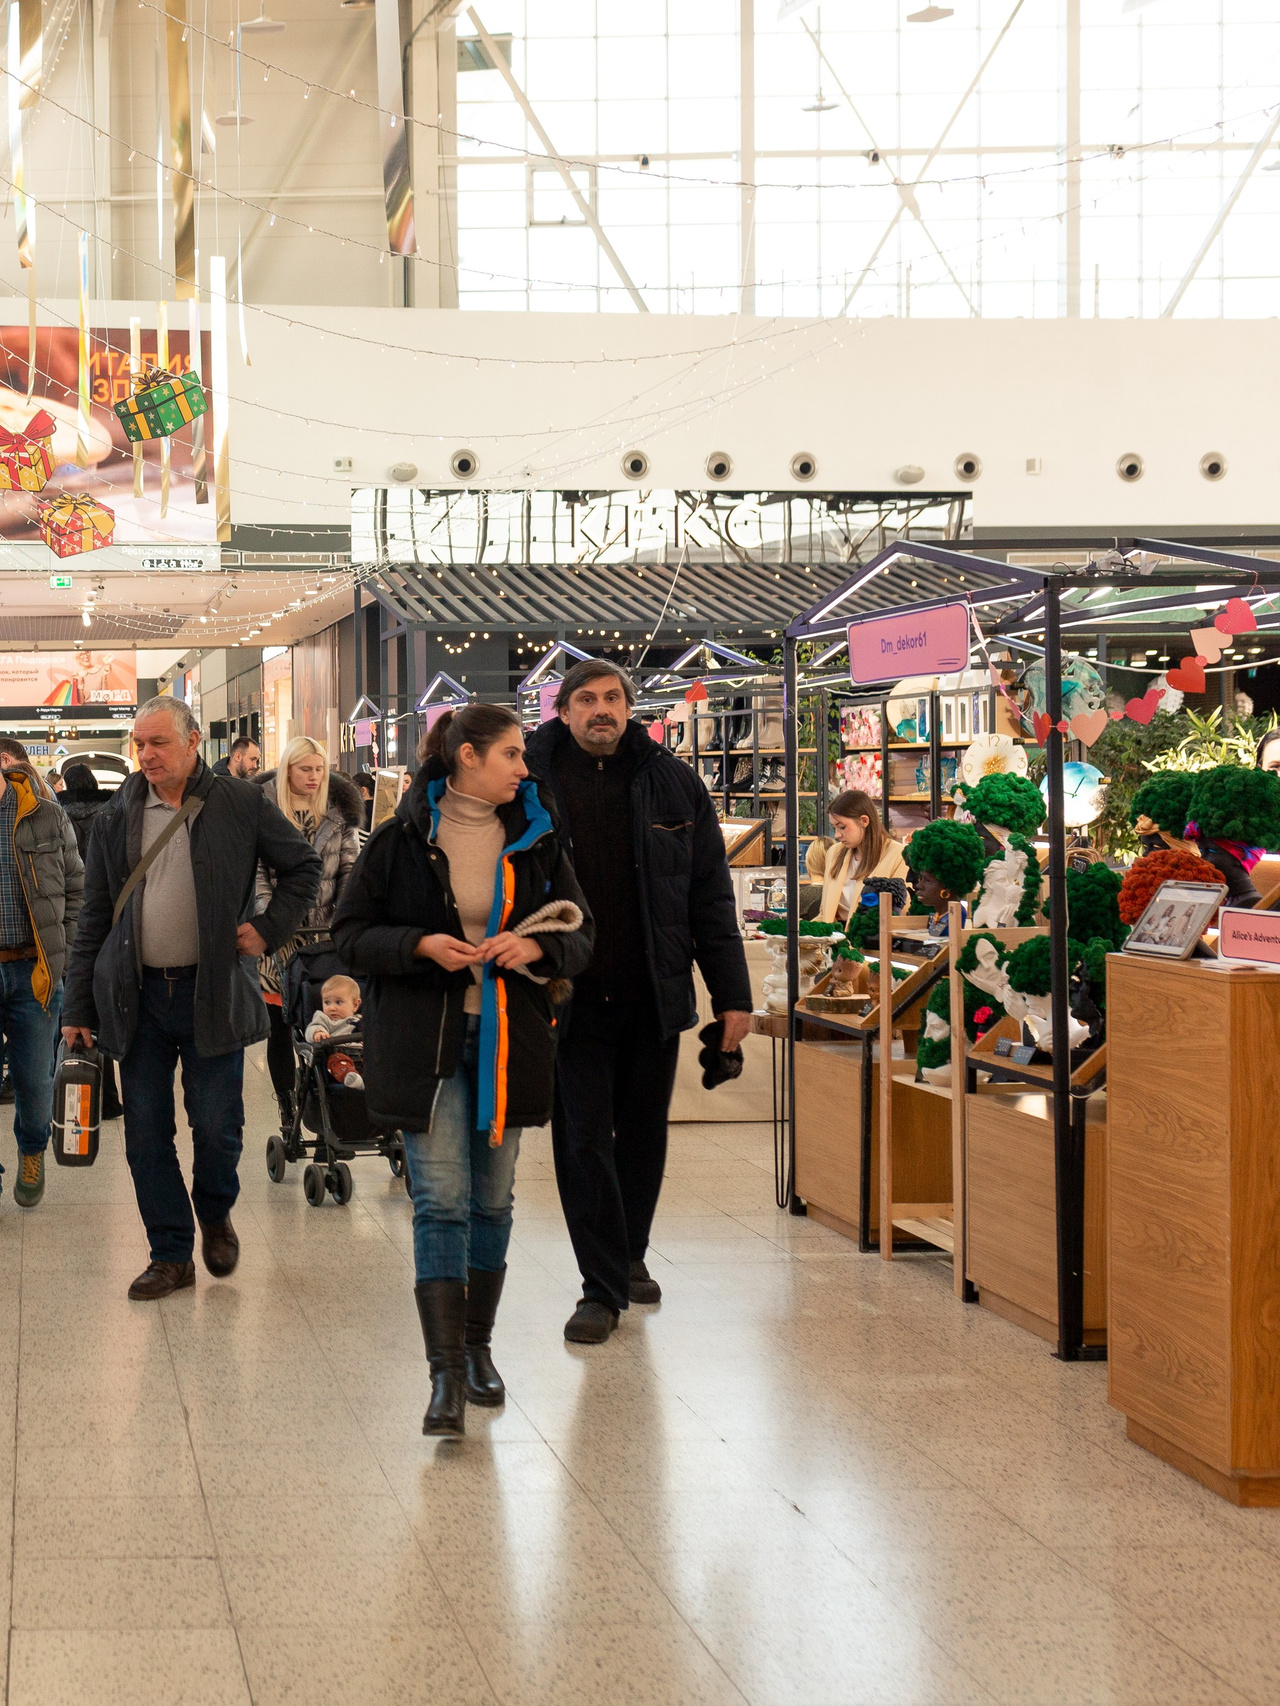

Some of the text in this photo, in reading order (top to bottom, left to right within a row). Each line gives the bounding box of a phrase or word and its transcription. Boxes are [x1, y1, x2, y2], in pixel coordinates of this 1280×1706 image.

[121, 547, 205, 557] Рестораны Каток
[880, 631, 928, 655] Dm_dekor61
[988, 735, 1000, 747] 12
[24, 746, 49, 756] РЛЕН
[1017, 757, 1027, 769] 3
[1231, 930, 1280, 944] Alice's Adventu
